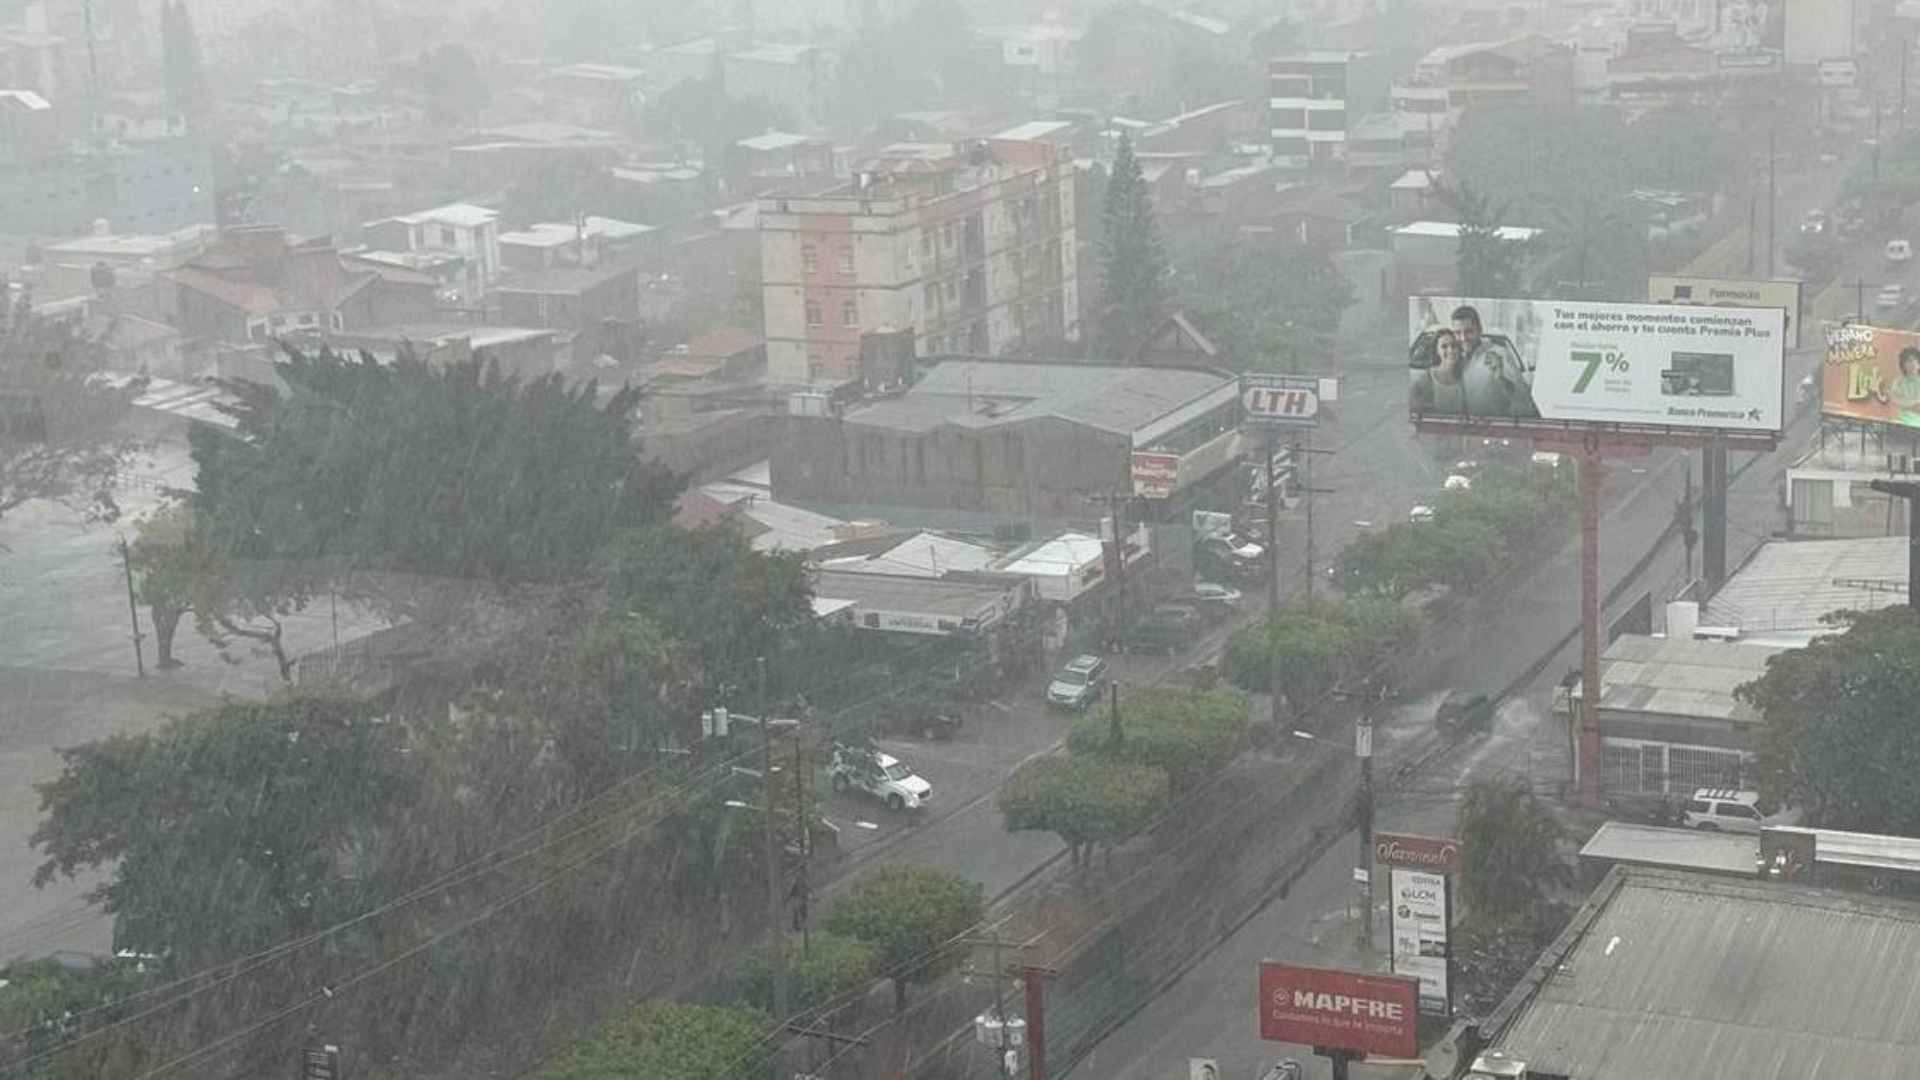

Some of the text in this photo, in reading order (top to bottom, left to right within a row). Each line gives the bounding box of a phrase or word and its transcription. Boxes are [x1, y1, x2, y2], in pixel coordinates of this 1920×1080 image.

[1554, 308, 1752, 325] Tus mejores momentos comienzan
[1554, 321, 1574, 330] con
[1578, 321, 1588, 331] el
[1591, 322, 1629, 332] ahorro
[1642, 324, 1655, 333] tu
[1657, 325, 1696, 335] cuenta
[1744, 327, 1770, 338] Plus
[1251, 390, 1308, 414] LTH
[1294, 990, 1403, 1021] MAPFRE
